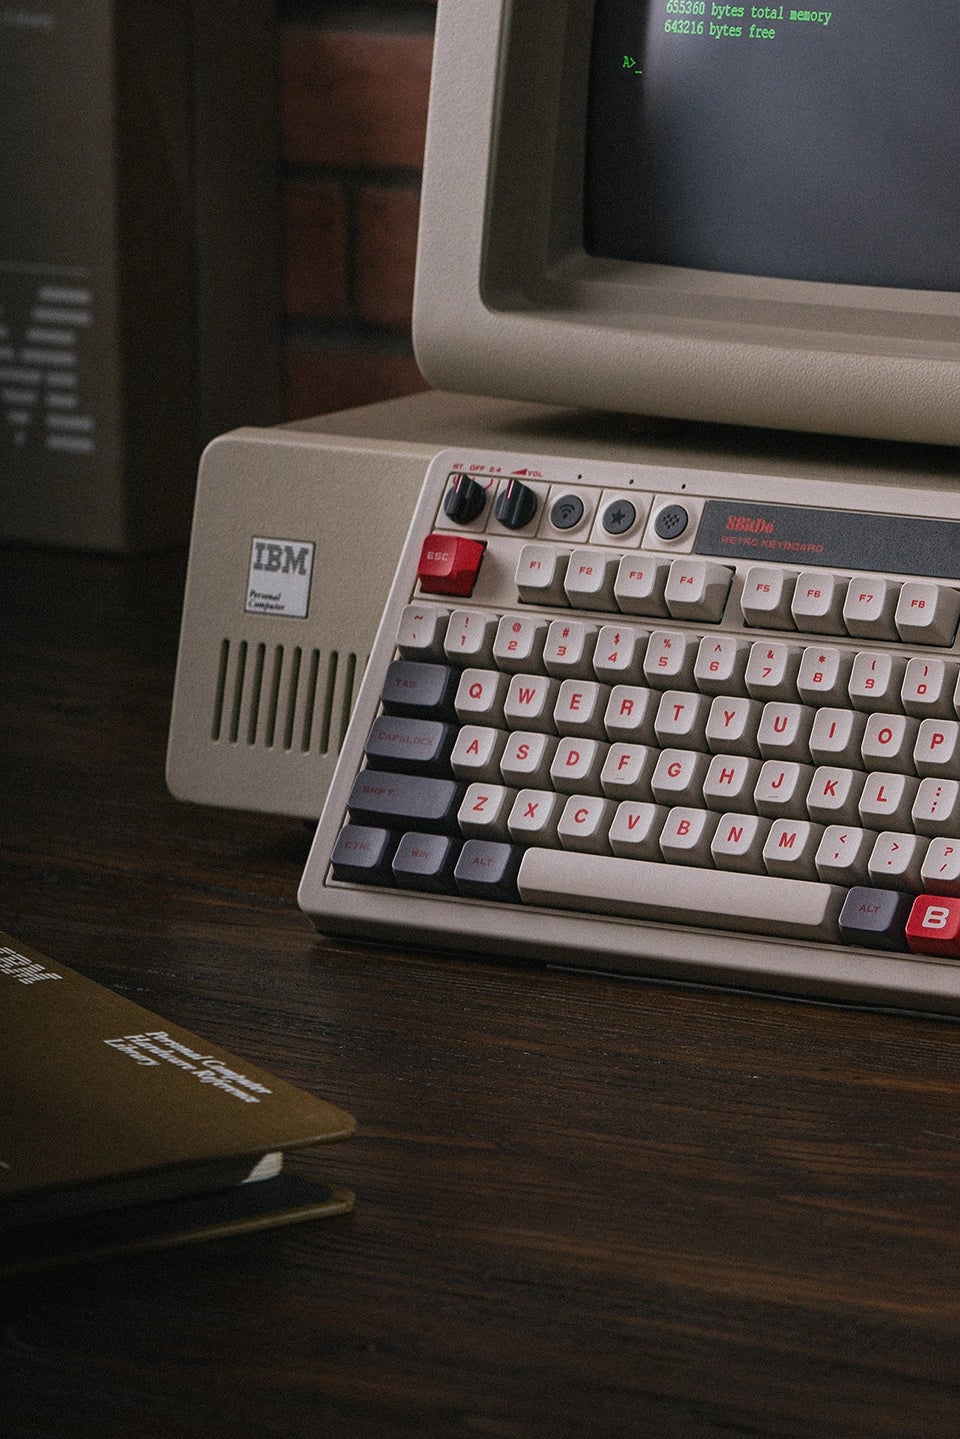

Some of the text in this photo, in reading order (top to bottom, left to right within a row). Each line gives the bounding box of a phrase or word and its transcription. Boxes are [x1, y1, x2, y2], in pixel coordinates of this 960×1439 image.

[666, 0, 833, 26] 655360 bytes total memory
[664, 19, 776, 40] 643216 bytes free
[526, 470, 544, 478] VOL
[725, 515, 775, 535] 8BitDo
[720, 535, 825, 554] RETRO KEYBOARD
[253, 542, 309, 575] IBM
[426, 551, 449, 561] ESC
[529, 560, 542, 569] F1
[578, 566, 593, 576] F2
[629, 570, 644, 581] F3
[679, 575, 695, 585] F4
[755, 583, 771, 593] F5
[806, 589, 822, 599] F6
[858, 593, 874, 604] F7
[910, 598, 927, 609] F8
[467, 681, 484, 700] Q
[517, 687, 537, 705] W
[568, 692, 583, 712] E
[618, 698, 636, 717] R
[672, 703, 685, 722] T
[723, 709, 736, 728] Y
[772, 715, 789, 734] U
[827, 721, 837, 740] I
[876, 726, 894, 745] O
[929, 732, 945, 750] P
[465, 738, 480, 756] A
[514, 742, 531, 762] S
[565, 749, 581, 768] D
[617, 753, 632, 771] F
[666, 761, 683, 779] G
[718, 767, 736, 785] H
[770, 772, 786, 790] J
[822, 778, 840, 798] K
[471, 794, 489, 813] Z
[875, 785, 888, 804] L
[522, 801, 540, 820] X
[573, 807, 589, 825] C
[626, 814, 641, 831] V
[675, 818, 692, 837] B
[726, 825, 744, 844] N
[777, 831, 798, 849] M
[472, 857, 493, 866] ALT
[859, 904, 881, 914] ALT
[921, 906, 950, 929] B
